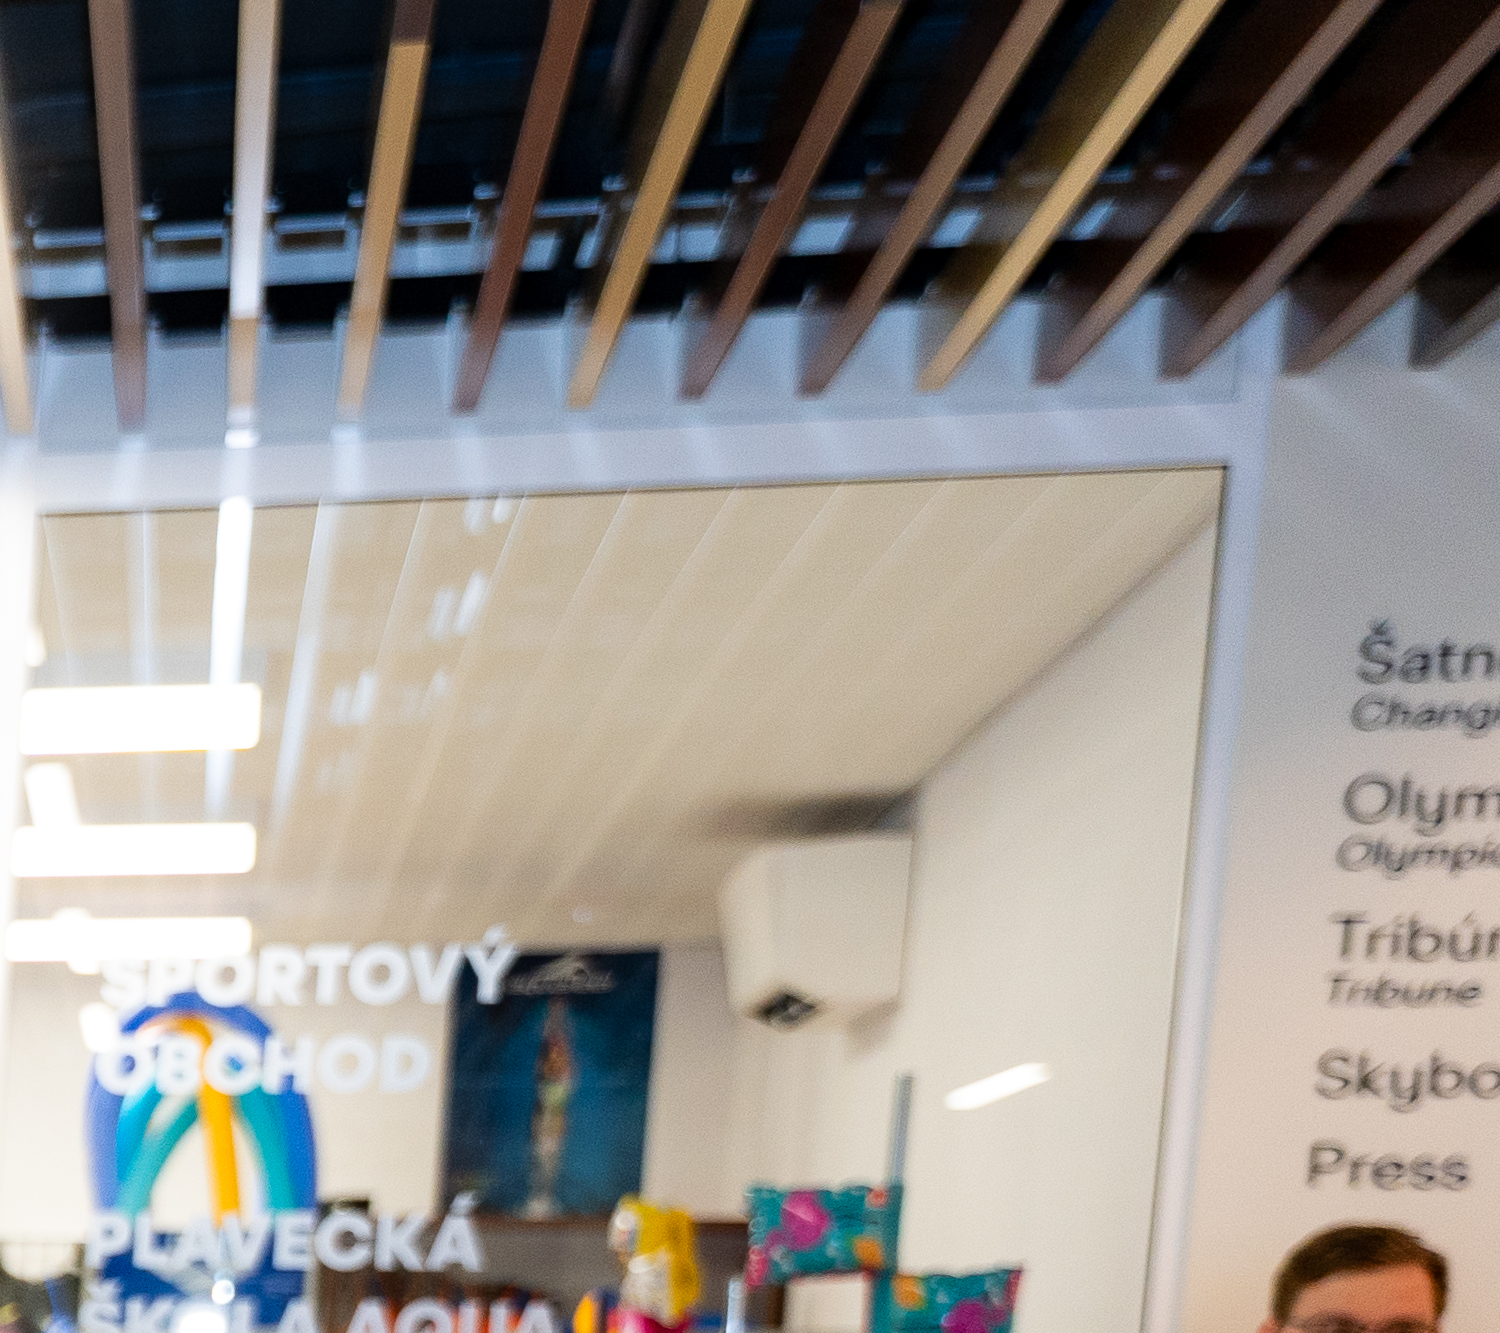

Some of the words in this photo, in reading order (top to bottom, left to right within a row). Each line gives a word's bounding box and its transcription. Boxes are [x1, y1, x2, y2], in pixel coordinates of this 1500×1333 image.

[1356, 618, 1500, 685] Šatn
[1350, 692, 1500, 739] Chang
[1342, 772, 1500, 838] Olym
[1335, 834, 1500, 880] Olympi
[1322, 968, 1484, 1008] Tribune
[94, 1032, 432, 1096] OBCHOD
[1313, 1047, 1500, 1113] Skybo
[1304, 1137, 1471, 1190] Press
[85, 1192, 484, 1272] PLAVECKÁ
